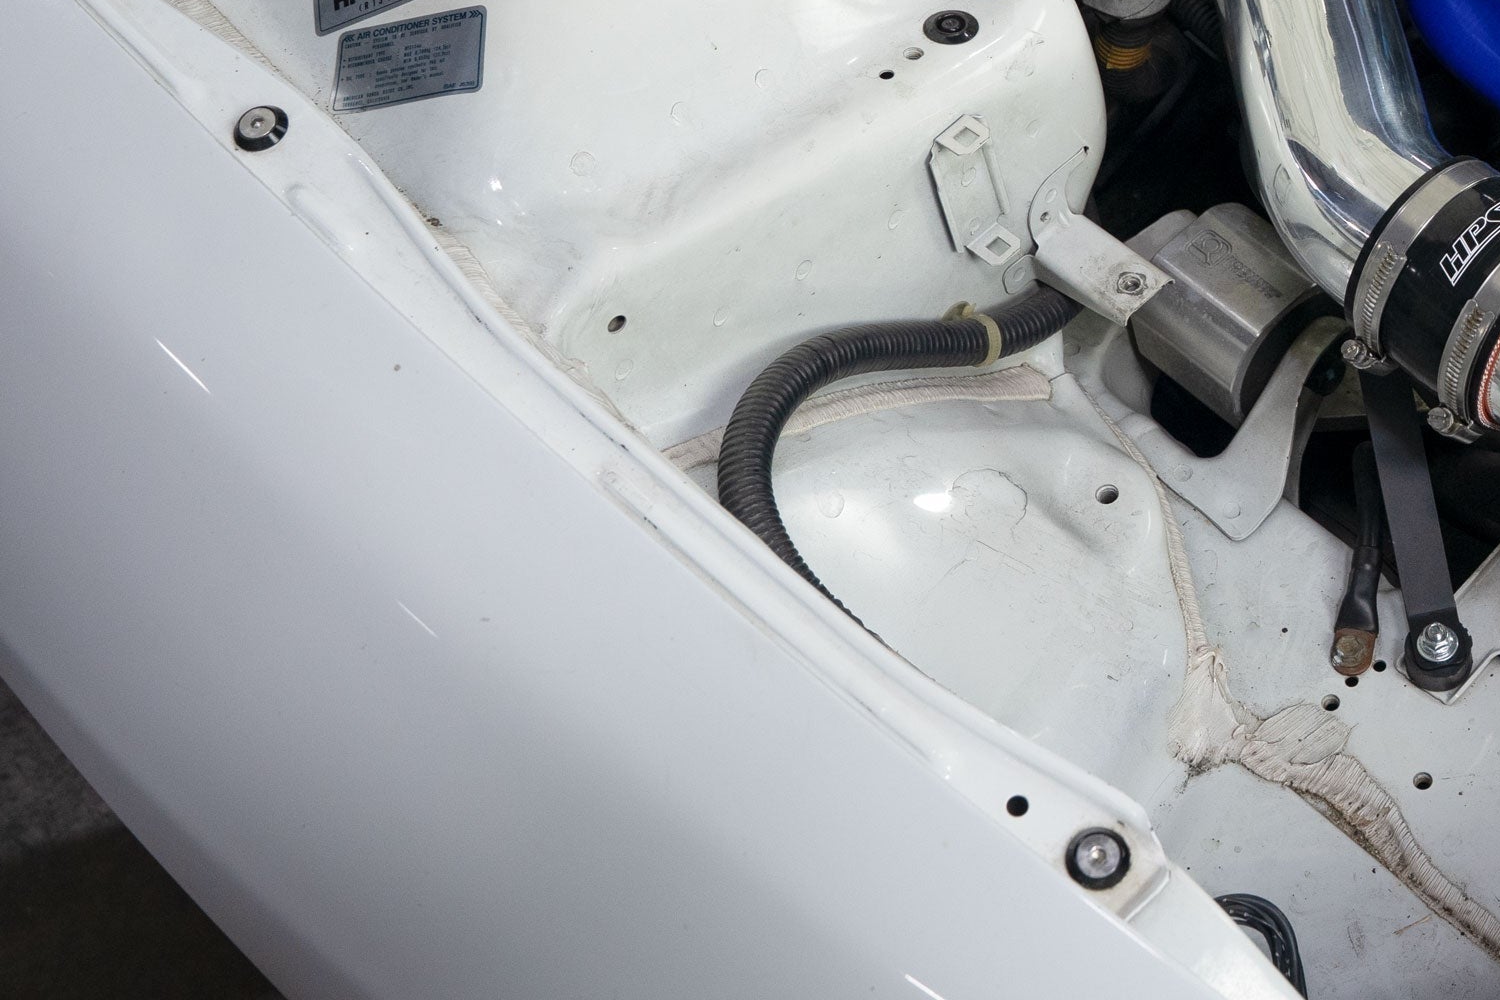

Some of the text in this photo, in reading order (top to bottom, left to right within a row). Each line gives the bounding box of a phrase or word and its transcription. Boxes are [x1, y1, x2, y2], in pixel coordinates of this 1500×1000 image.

[357, 12, 467, 41] AIR CONDITIONER SYSTEM
